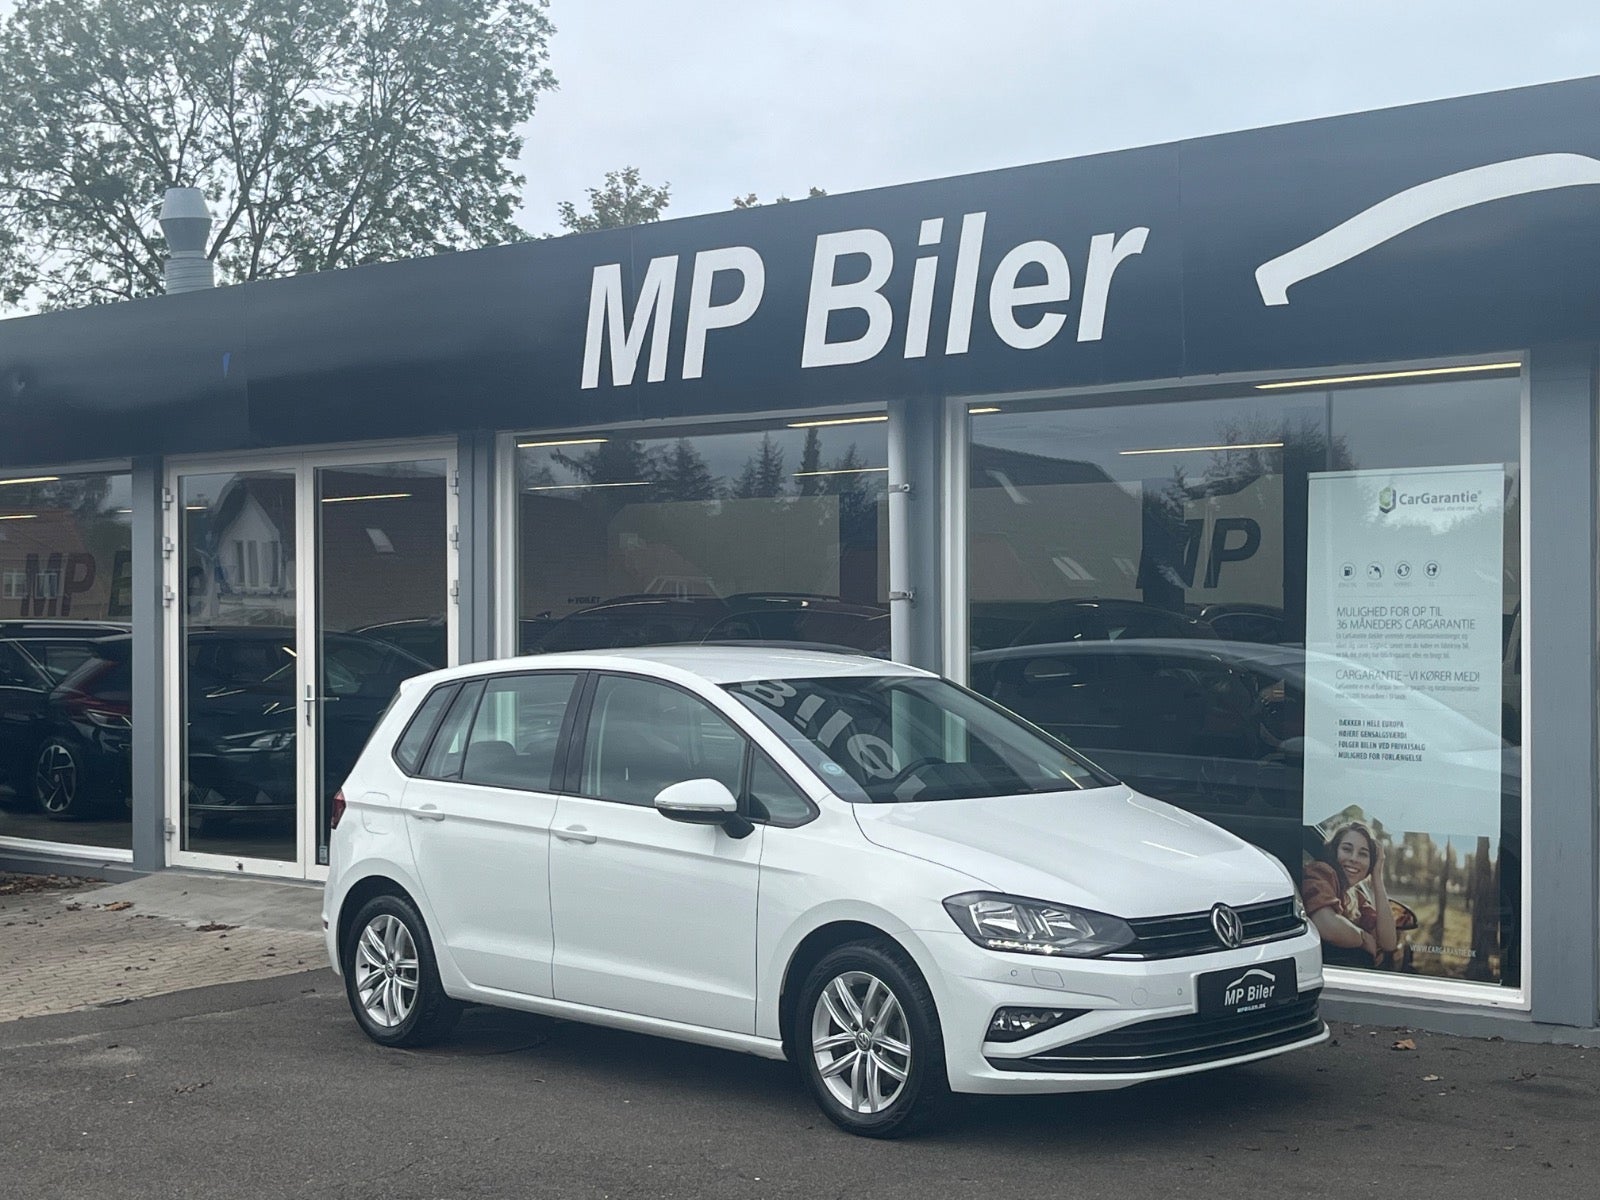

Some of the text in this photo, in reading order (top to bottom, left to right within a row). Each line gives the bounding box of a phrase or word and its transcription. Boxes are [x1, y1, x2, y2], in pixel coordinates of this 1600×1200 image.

[581, 211, 1150, 389] MP Biler
[1336, 606, 1443, 617] MULIGHED FOR OP TIL
[1336, 617, 1476, 630] 36 MÅNEDERS CARGARANTIE
[1420, 670, 1451, 681] KØRER
[1224, 984, 1275, 1006] MP Biler
